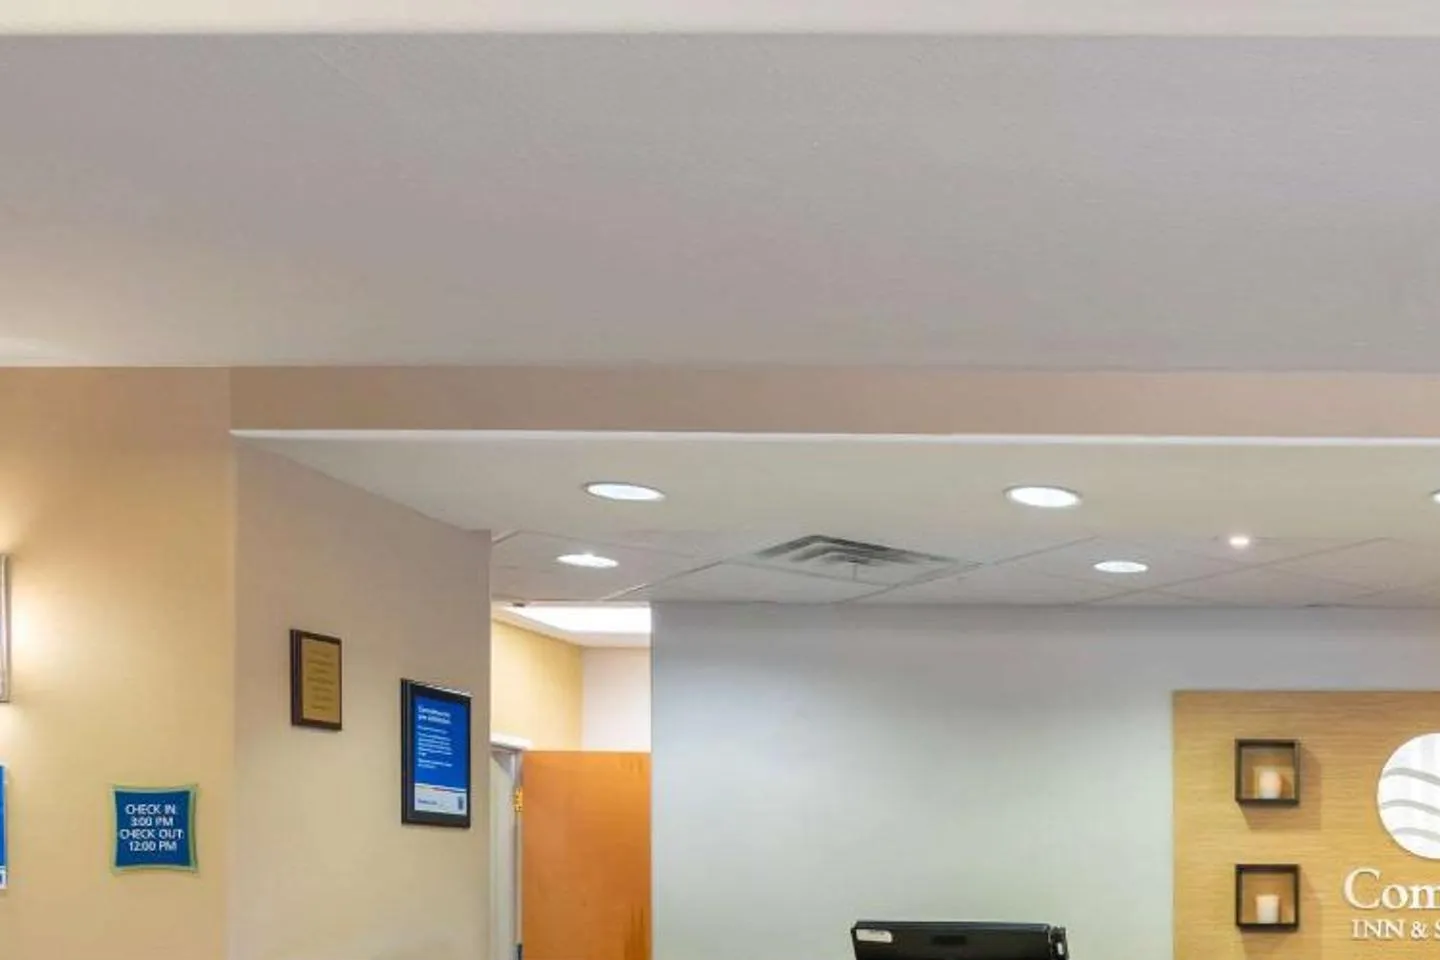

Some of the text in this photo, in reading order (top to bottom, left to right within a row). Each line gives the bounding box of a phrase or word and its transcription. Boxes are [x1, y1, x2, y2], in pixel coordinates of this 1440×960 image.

[155, 816, 174, 827] PM
[159, 841, 178, 852] PM
[1352, 918, 1406, 940] INN
[1410, 919, 1429, 940] &
